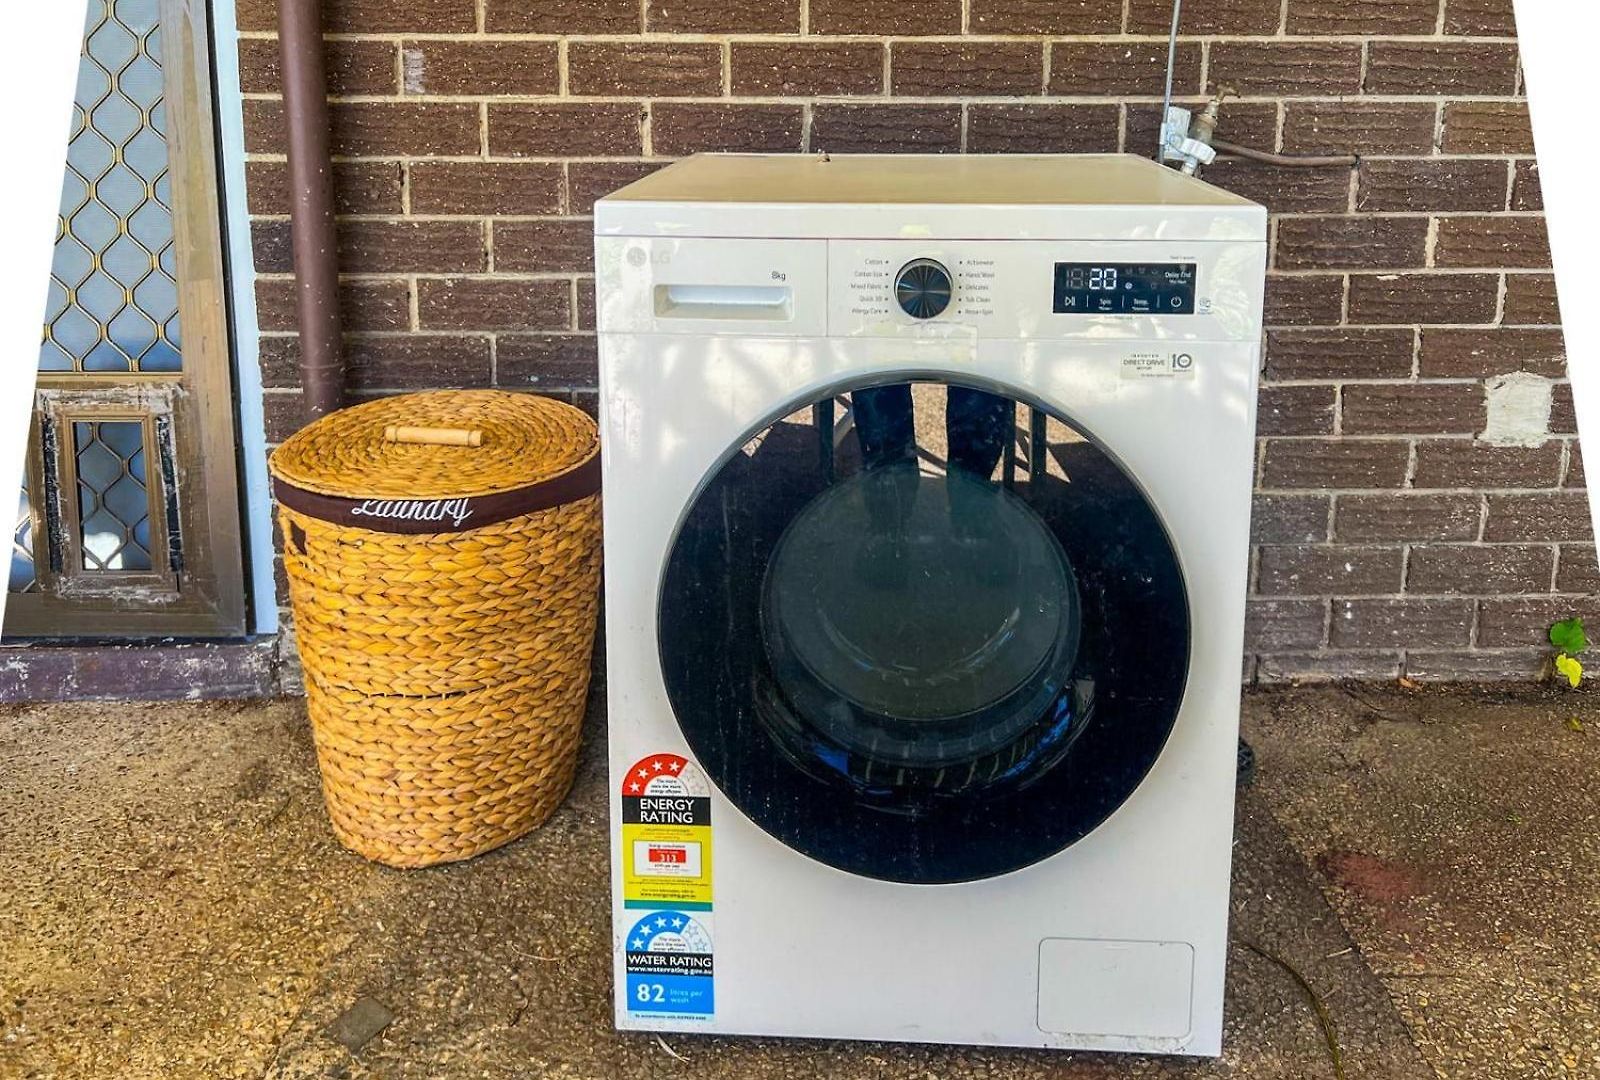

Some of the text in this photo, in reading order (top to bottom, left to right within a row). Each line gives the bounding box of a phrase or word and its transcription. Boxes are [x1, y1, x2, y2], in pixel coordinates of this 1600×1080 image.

[351, 498, 473, 527] Laundry
[640, 798, 695, 810] ENERGY
[640, 811, 694, 824] RATING
[627, 954, 712, 967] WATER RATING
[627, 966, 713, 976] www.waterrating.gov.au
[637, 983, 666, 1003] 82
[690, 990, 704, 998] per
